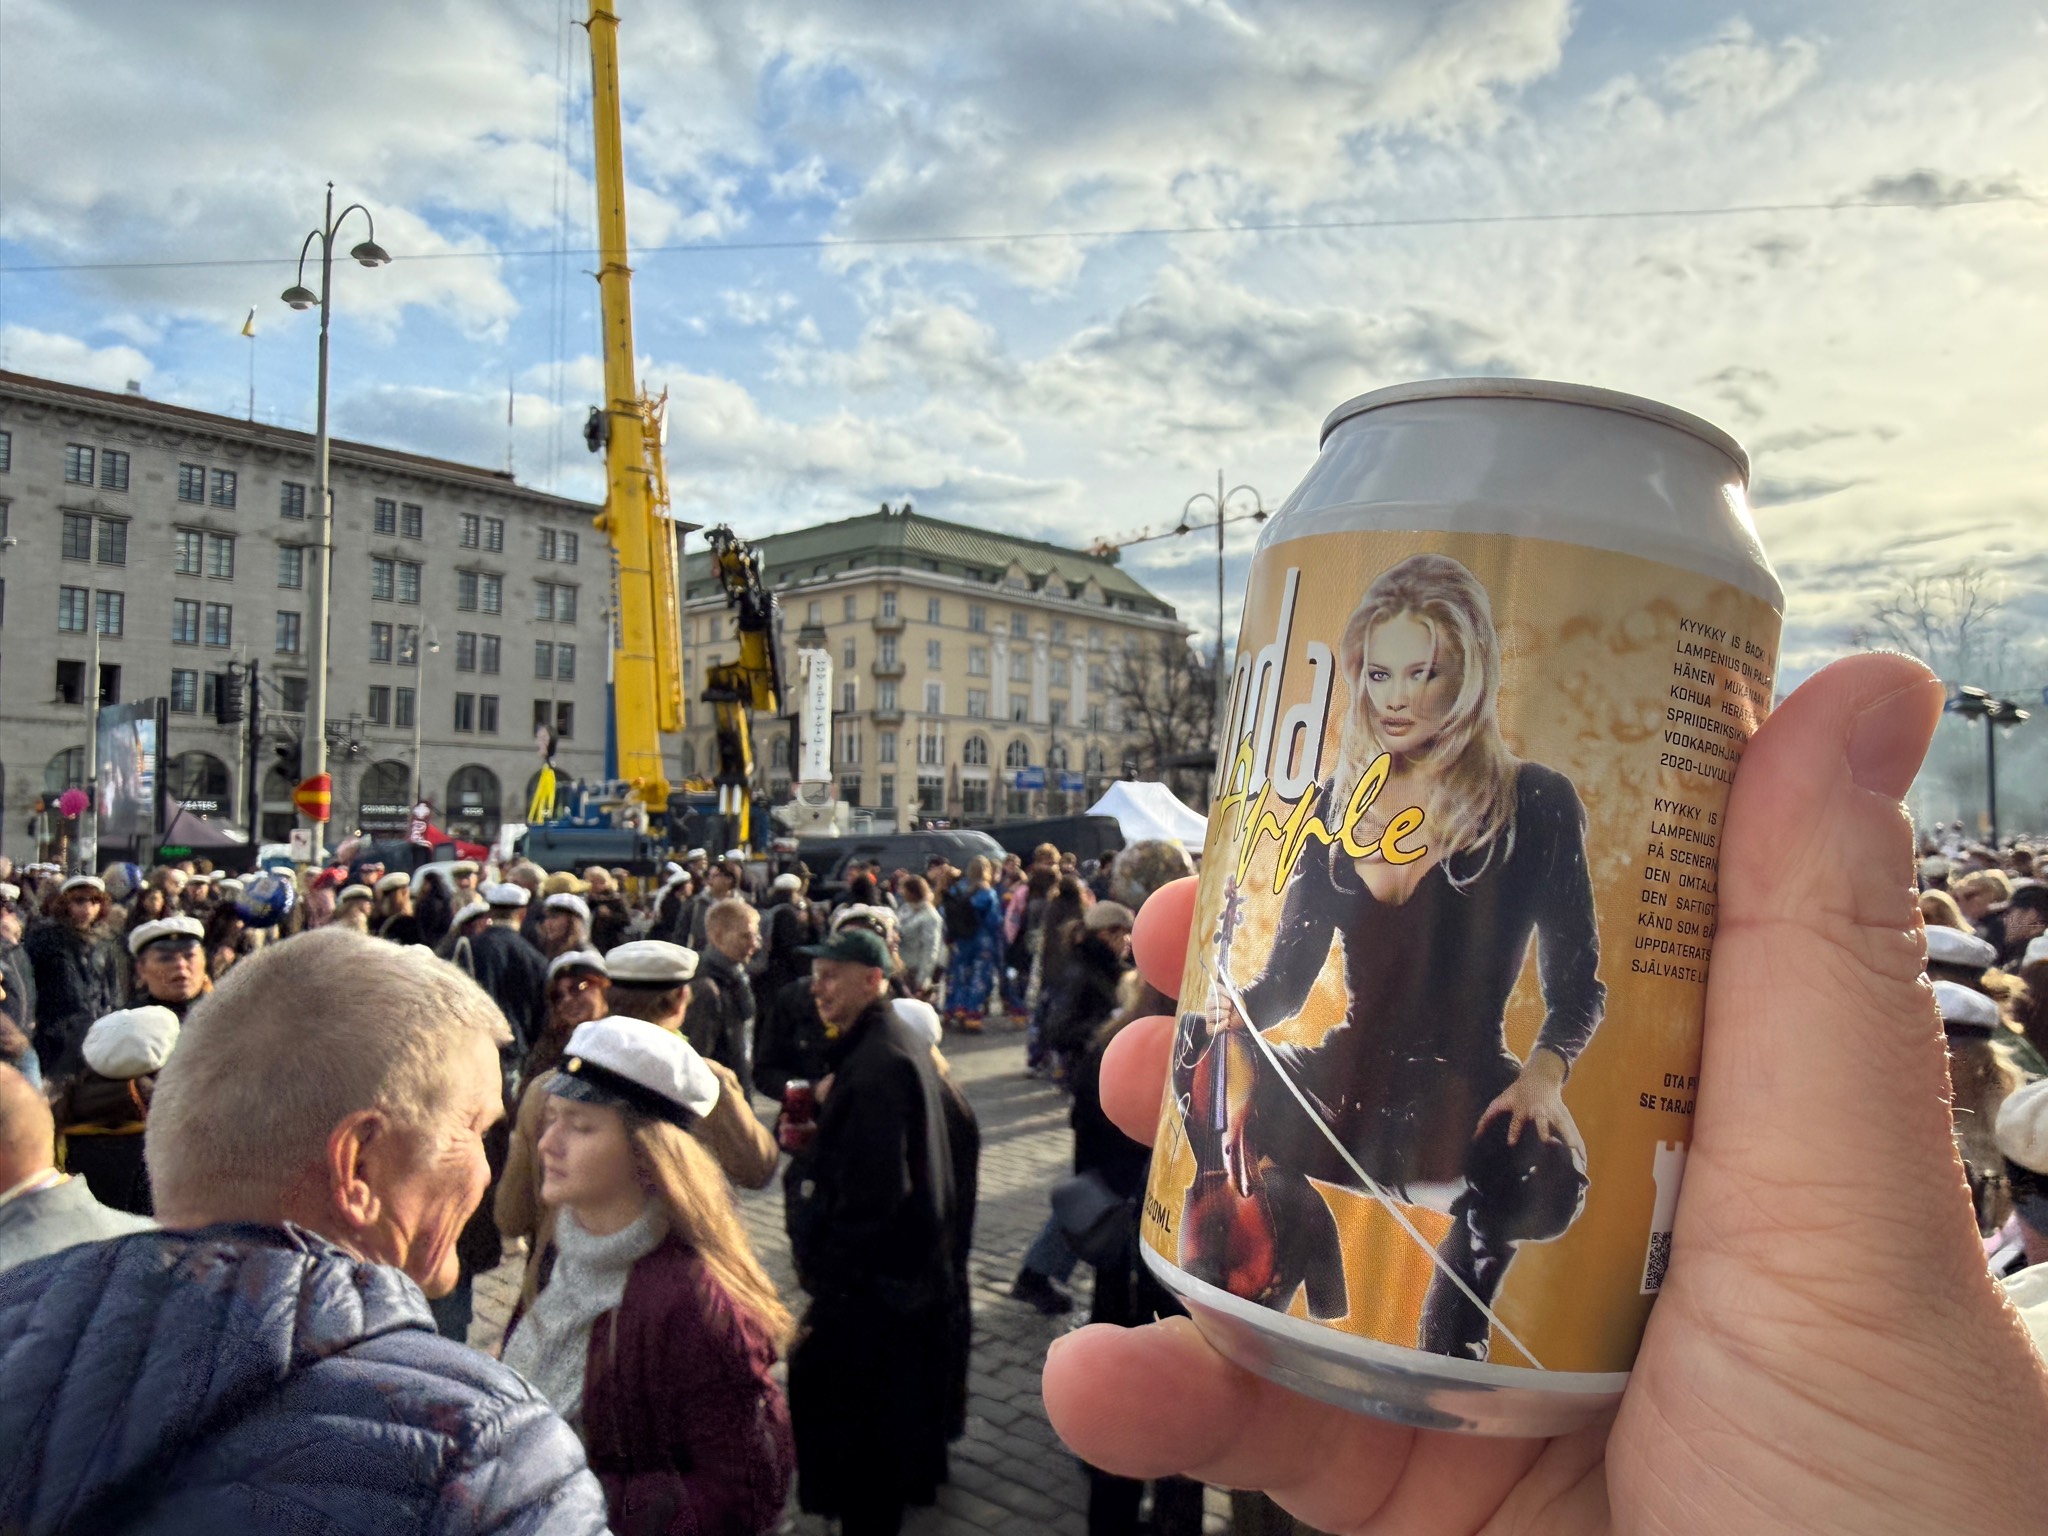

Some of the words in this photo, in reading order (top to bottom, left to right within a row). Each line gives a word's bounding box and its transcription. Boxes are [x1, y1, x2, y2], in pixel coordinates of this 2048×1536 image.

[1680, 618, 1726, 642] KYYKKY
[1731, 635, 1741, 649] IS
[1676, 640, 1740, 672] LAMPENIUS
[1742, 663, 1753, 679] ON
[1673, 661, 1715, 686] HÄNEN
[1670, 685, 1711, 708] KOHUA
[1213, 731, 1428, 895] Apple
[1654, 798, 1701, 821] KYYKKY
[1708, 812, 1718, 826] IS
[1651, 820, 1716, 848] LAMPENIUS
[1648, 841, 1664, 859] PÅ
[1645, 866, 1670, 884] DEN
[1642, 889, 1667, 907] DEN
[1638, 911, 1672, 932] KÄND
[1677, 920, 1699, 936] SOM
[1631, 959, 1696, 982] SJÄLVASTE
[1664, 1072, 1684, 1089] OTA
[1640, 1092, 1656, 1110] SE
